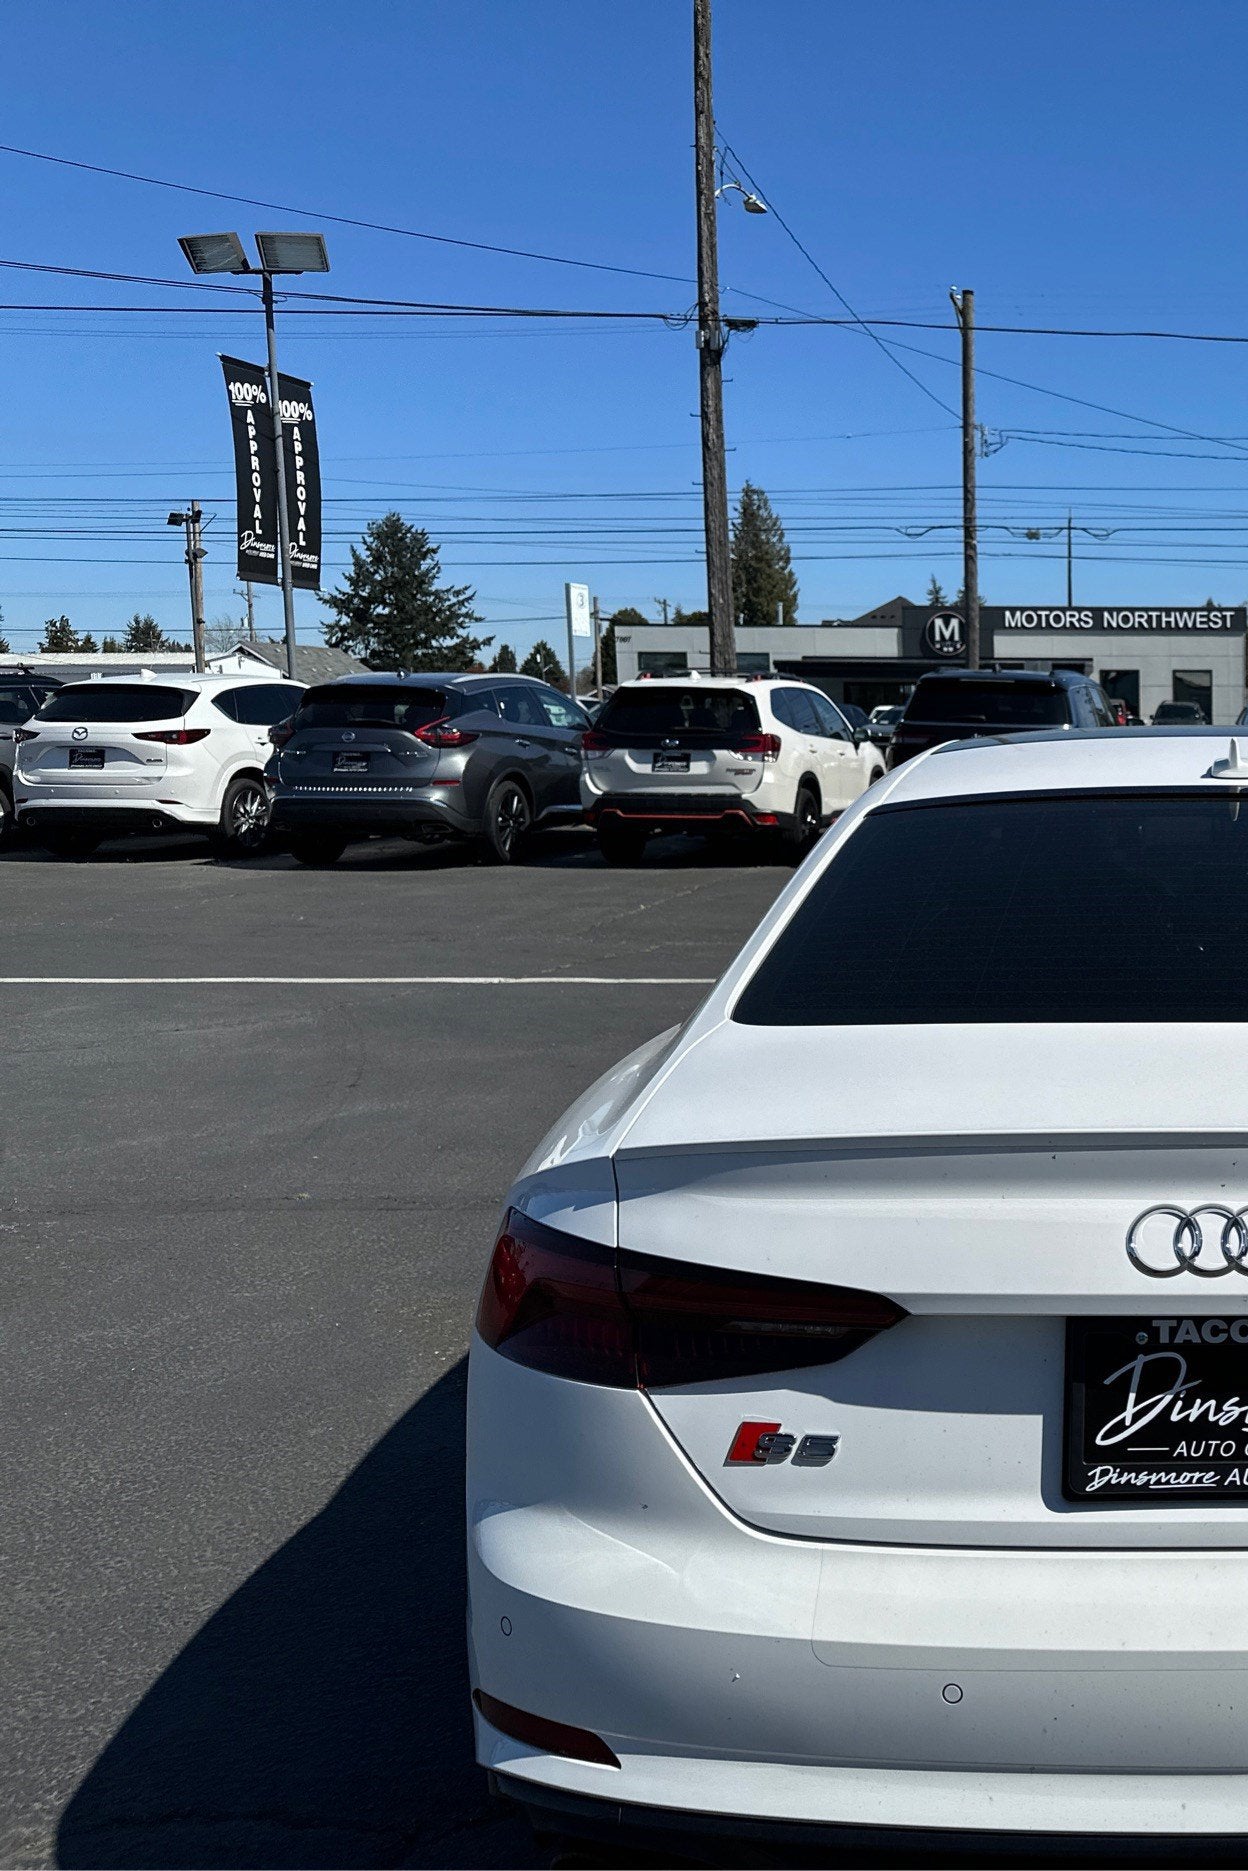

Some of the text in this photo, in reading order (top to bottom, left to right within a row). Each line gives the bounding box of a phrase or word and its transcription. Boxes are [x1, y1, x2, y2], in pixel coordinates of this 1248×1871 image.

[229, 382, 267, 404] 100%
[279, 400, 313, 421] 100%
[246, 409, 263, 535] APPROVAL
[292, 426, 306, 546] APPROVAL
[934, 618, 959, 641] M
[1004, 610, 1235, 629] MOTORS NORTHWEST
[754, 1432, 841, 1467] S5
[1173, 1440, 1236, 1457] AUTO
[1085, 1465, 1221, 1491] Dinsmore
